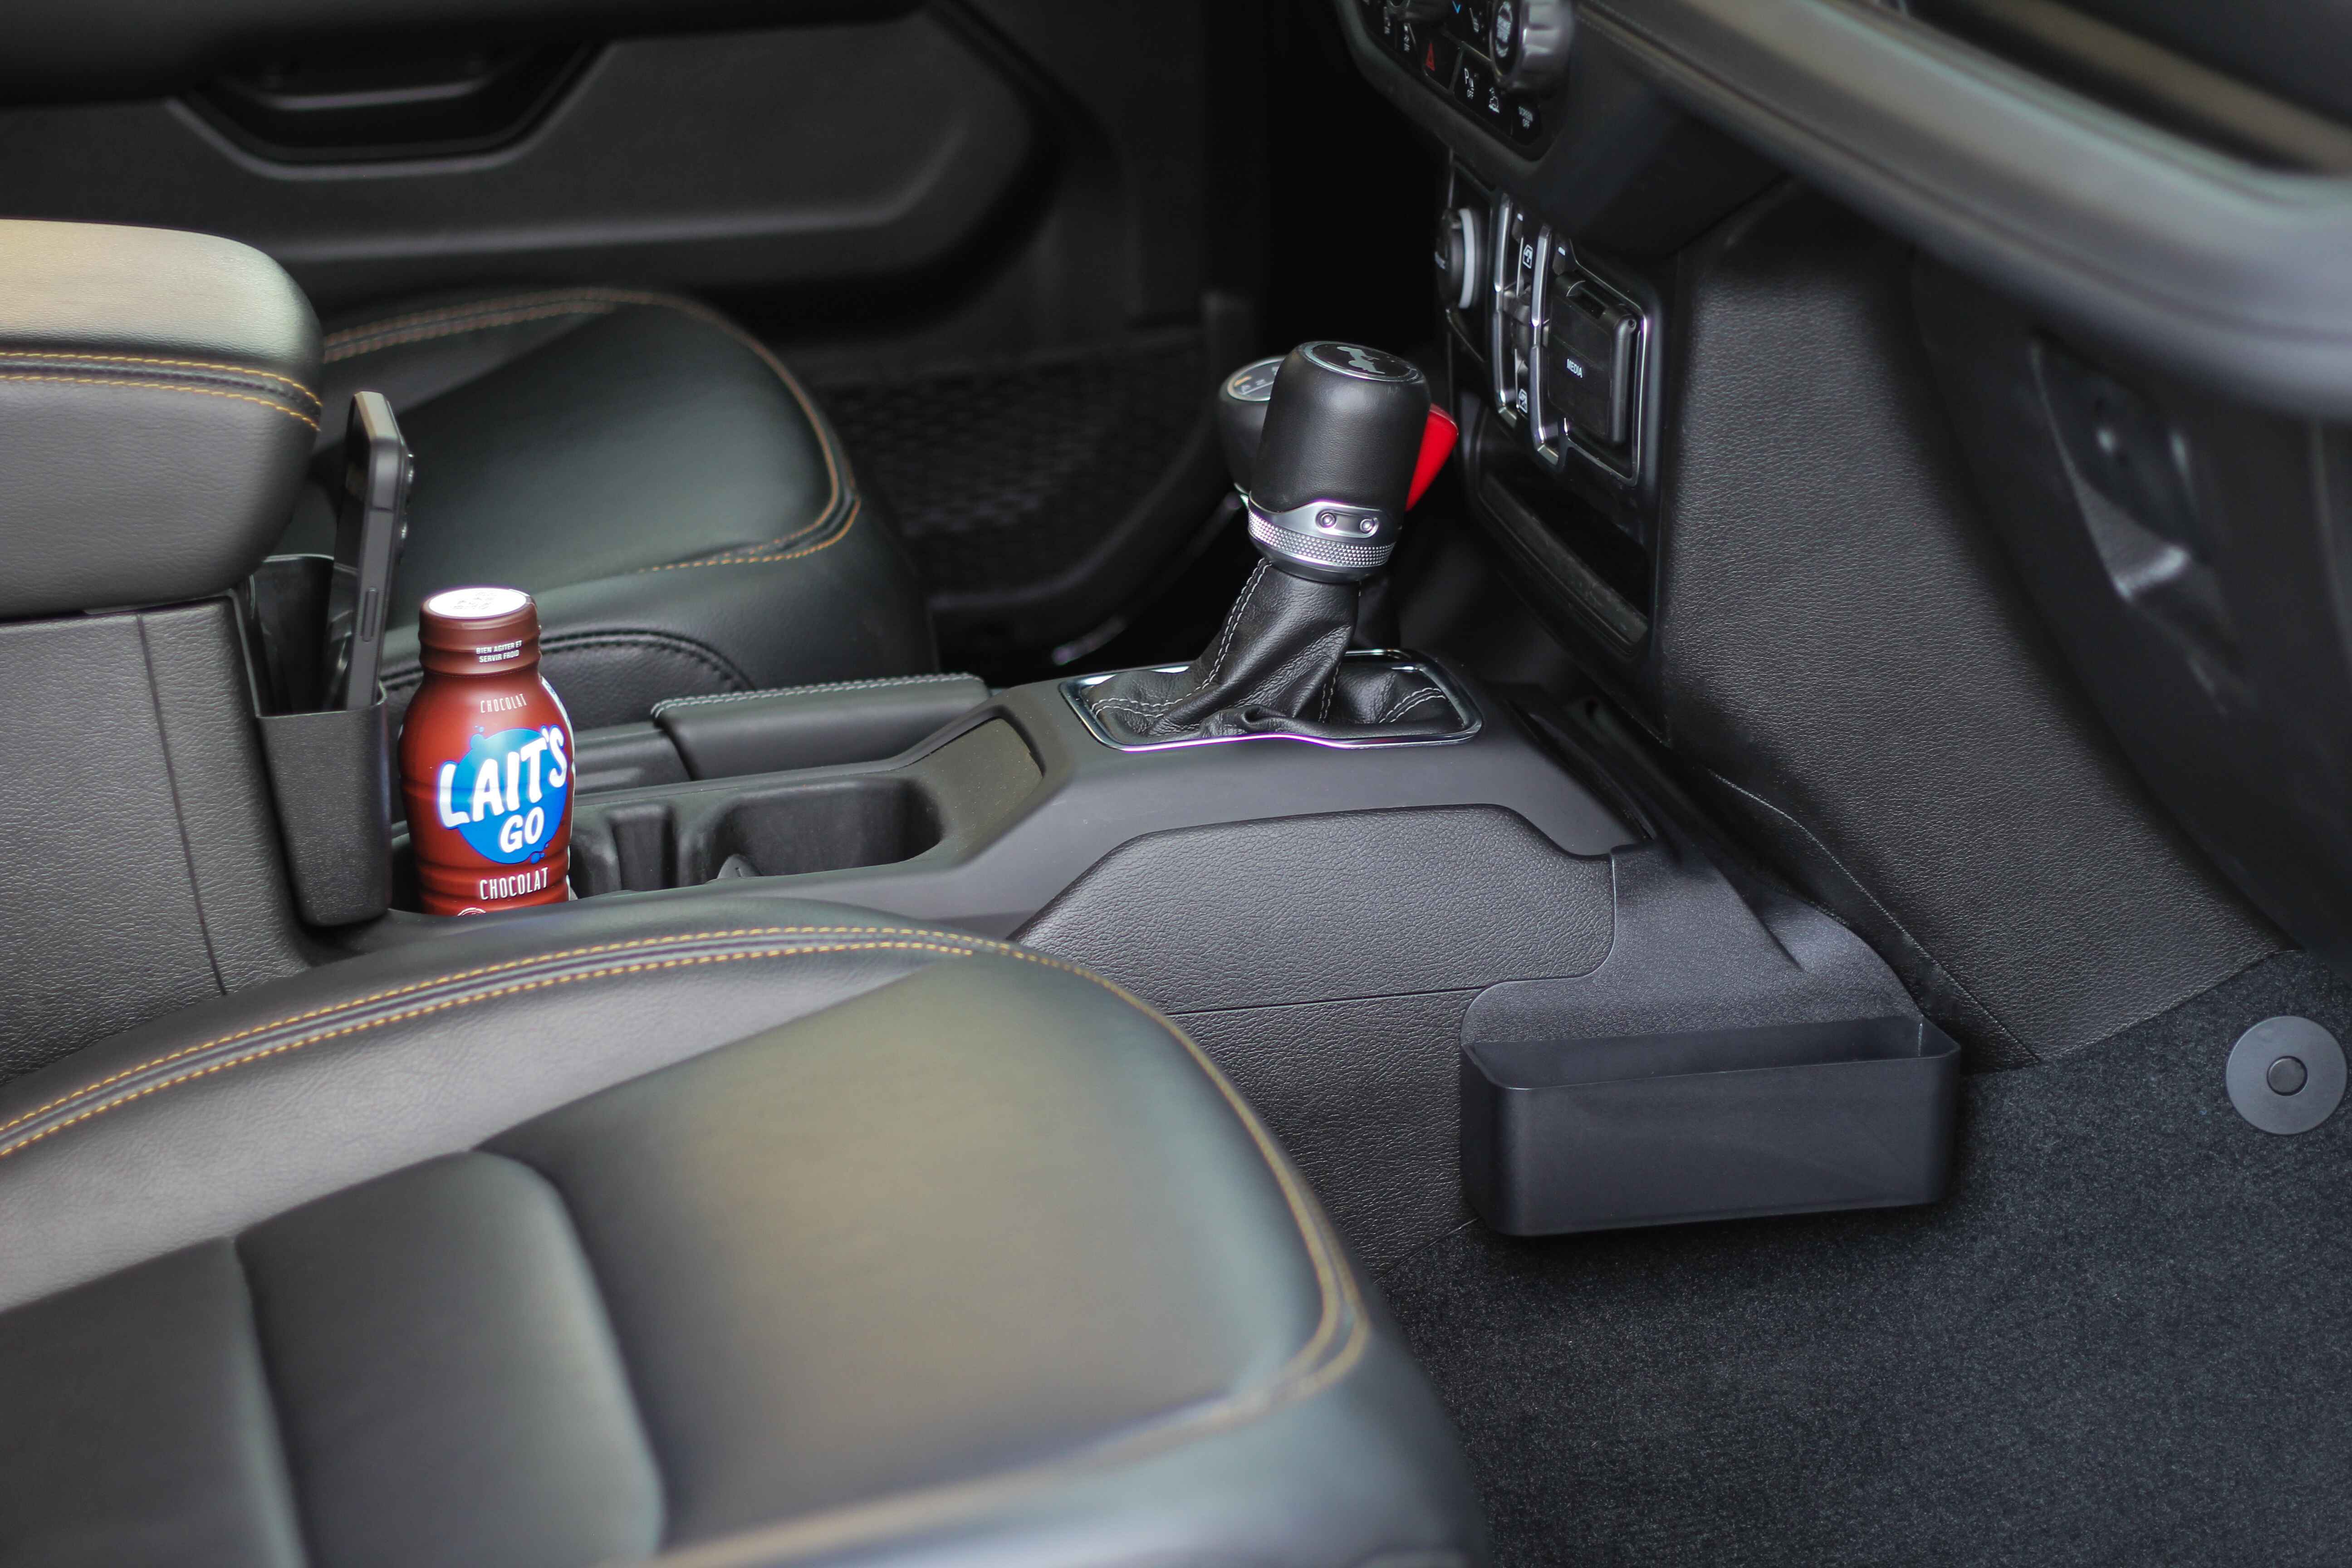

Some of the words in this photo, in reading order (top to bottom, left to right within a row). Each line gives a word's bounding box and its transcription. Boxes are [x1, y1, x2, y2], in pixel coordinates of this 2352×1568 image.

[1566, 358, 1583, 378] MEDIA
[479, 654, 502, 662] SERVIR
[503, 650, 519, 660] FROID
[493, 642, 514, 652] AGITER
[515, 640, 522, 648] ET
[480, 693, 527, 713] CHOCOLAT
[439, 727, 567, 828] LAIT'S
[500, 806, 544, 853] GO
[480, 867, 549, 900] CHOCOLAT
